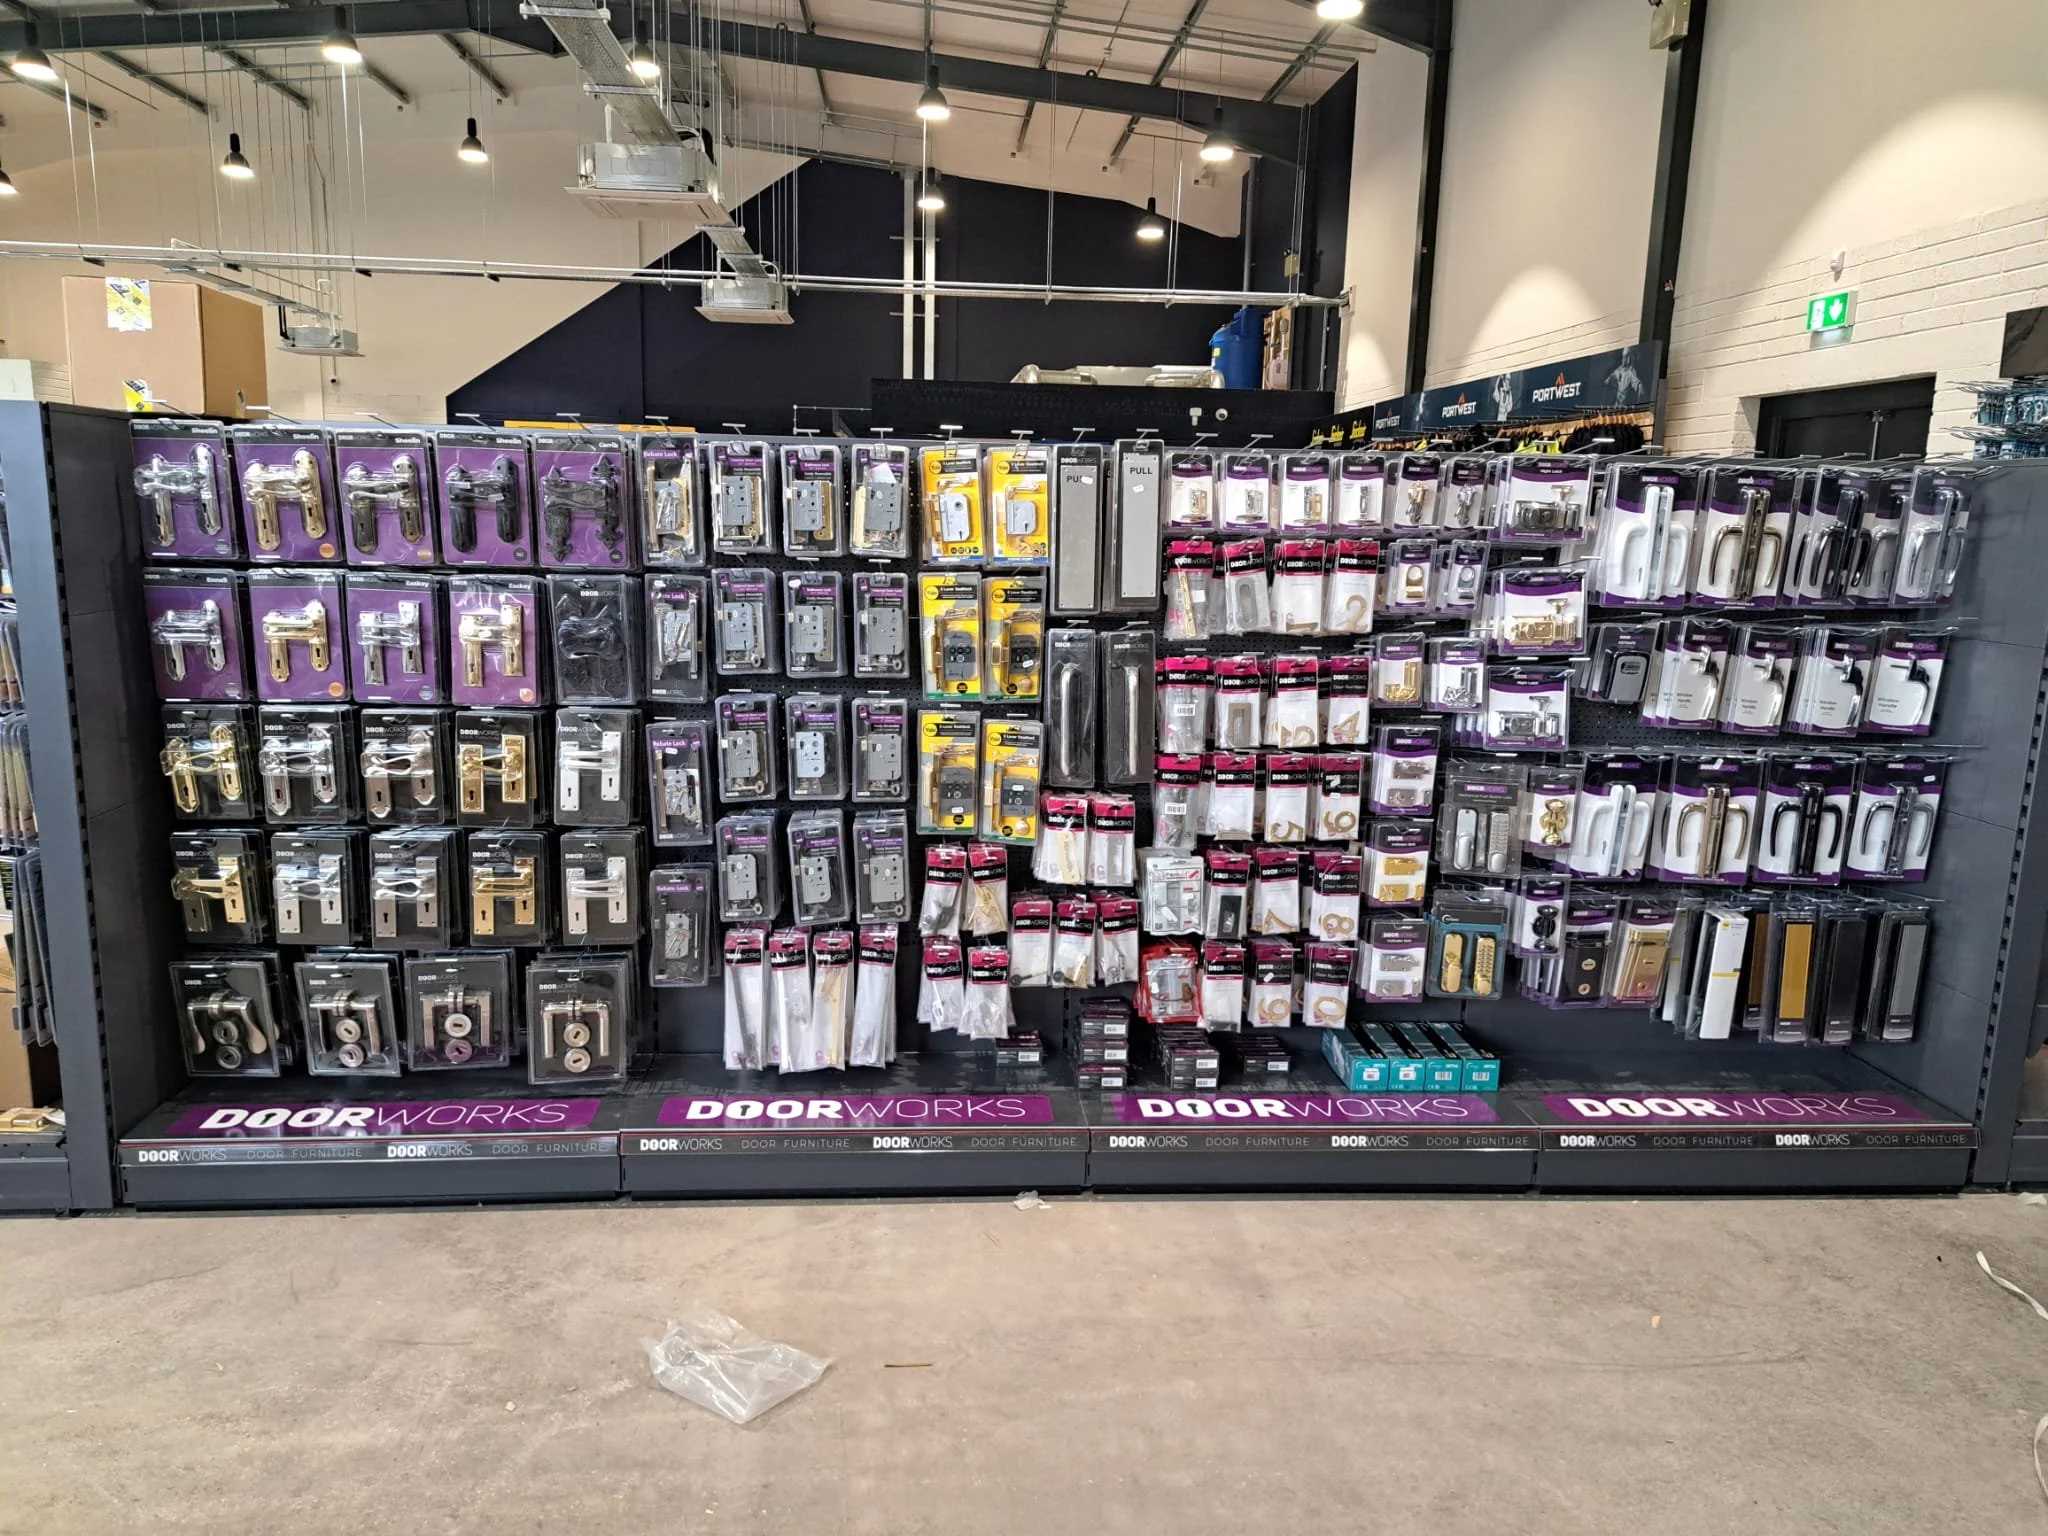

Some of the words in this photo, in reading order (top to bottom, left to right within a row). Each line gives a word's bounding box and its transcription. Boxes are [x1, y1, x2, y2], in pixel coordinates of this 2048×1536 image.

[1532, 382, 1581, 403] PORTWEST
[1442, 402, 1476, 418] PORTWEST
[496, 437, 522, 445] Sheelin
[1130, 466, 1153, 475] PULL
[686, 1099, 1026, 1120] DOORWORKS
[1137, 1098, 1468, 1118] DOORWORKS
[1567, 1097, 1897, 1117] DOORWORKS
[200, 1104, 569, 1129] DOORWORKS
[640, 1138, 723, 1151] DOORWORKS
[741, 1138, 776, 1149] DOOR
[784, 1137, 850, 1149] FURNITURE
[873, 1135, 953, 1149] DOORWORKS
[971, 1137, 1006, 1148] DOOR
[1012, 1136, 1077, 1148] FURNITURE
[1109, 1135, 1188, 1148] DOORWORKS
[1205, 1137, 1239, 1147] DOOR
[1246, 1136, 1310, 1147] FURNITURE
[1331, 1135, 1409, 1148] DOORWORKS
[1426, 1136, 1459, 1146] DOOR
[1466, 1136, 1529, 1147] FURNITURE
[1560, 1135, 1636, 1147] DOORWORKS
[1653, 1136, 1686, 1146] DOOR
[1692, 1136, 1753, 1146] FURNITURE
[1775, 1134, 1850, 1147] DOORWORKS
[1866, 1135, 1898, 1145] DOOR
[1905, 1134, 1967, 1145] FURNITURE
[139, 1149, 227, 1163] DOORWORKS
[246, 1149, 284, 1160] DOOR
[292, 1147, 362, 1159] FURNITURE
[387, 1143, 473, 1158] DOORWORKS
[492, 1144, 529, 1154] DOOR
[536, 1142, 608, 1154] FURNITURE
